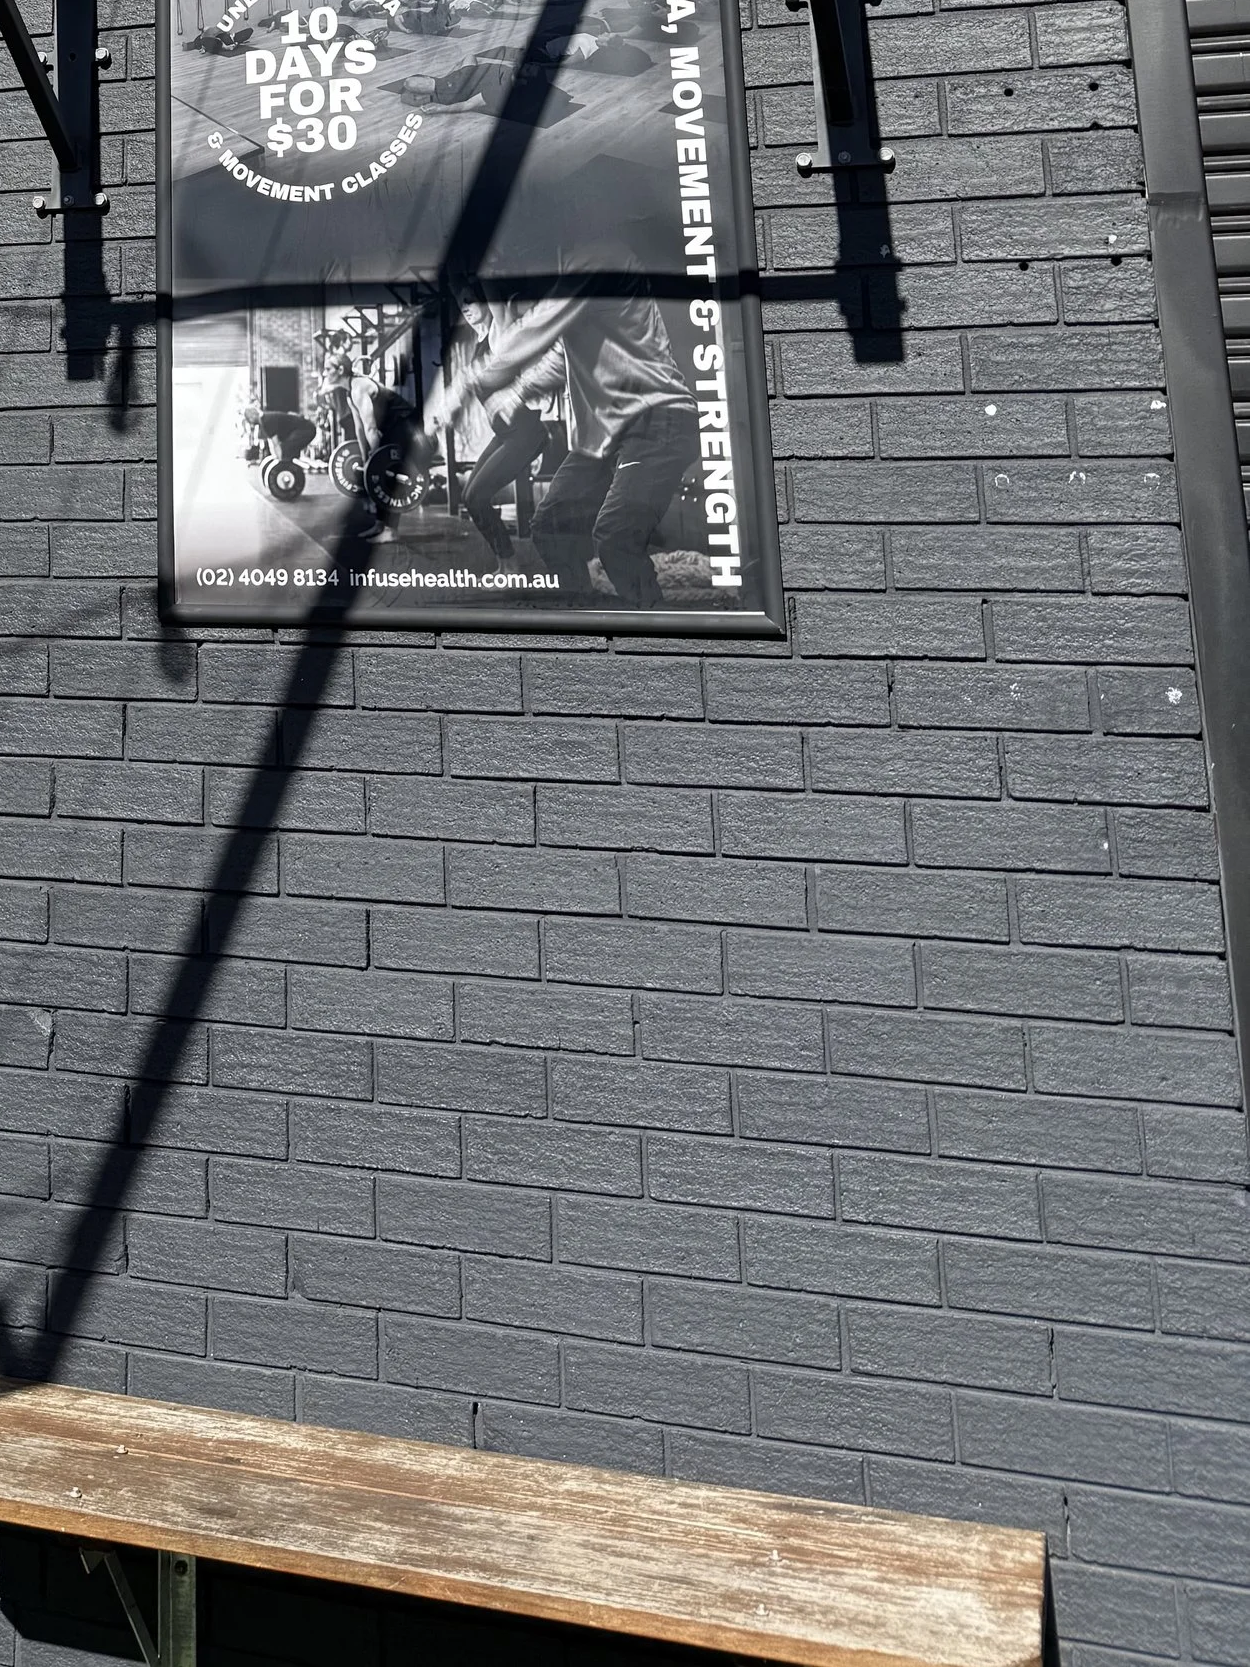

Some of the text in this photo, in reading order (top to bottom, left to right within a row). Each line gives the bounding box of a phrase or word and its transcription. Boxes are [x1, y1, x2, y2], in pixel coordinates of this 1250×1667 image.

[280, 5, 338, 45] 10
[244, 39, 377, 85] DAYS
[259, 78, 363, 119] FOR
[207, 111, 425, 203] & MOVEMENT CLASSES
[266, 115, 358, 158] $30
[668, 47, 716, 290] MOVEMENT
[688, 299, 721, 333] &
[693, 344, 742, 587] STRENGTH
[196, 567, 560, 591] (02) 4049 8134 infusehealth.com.au
